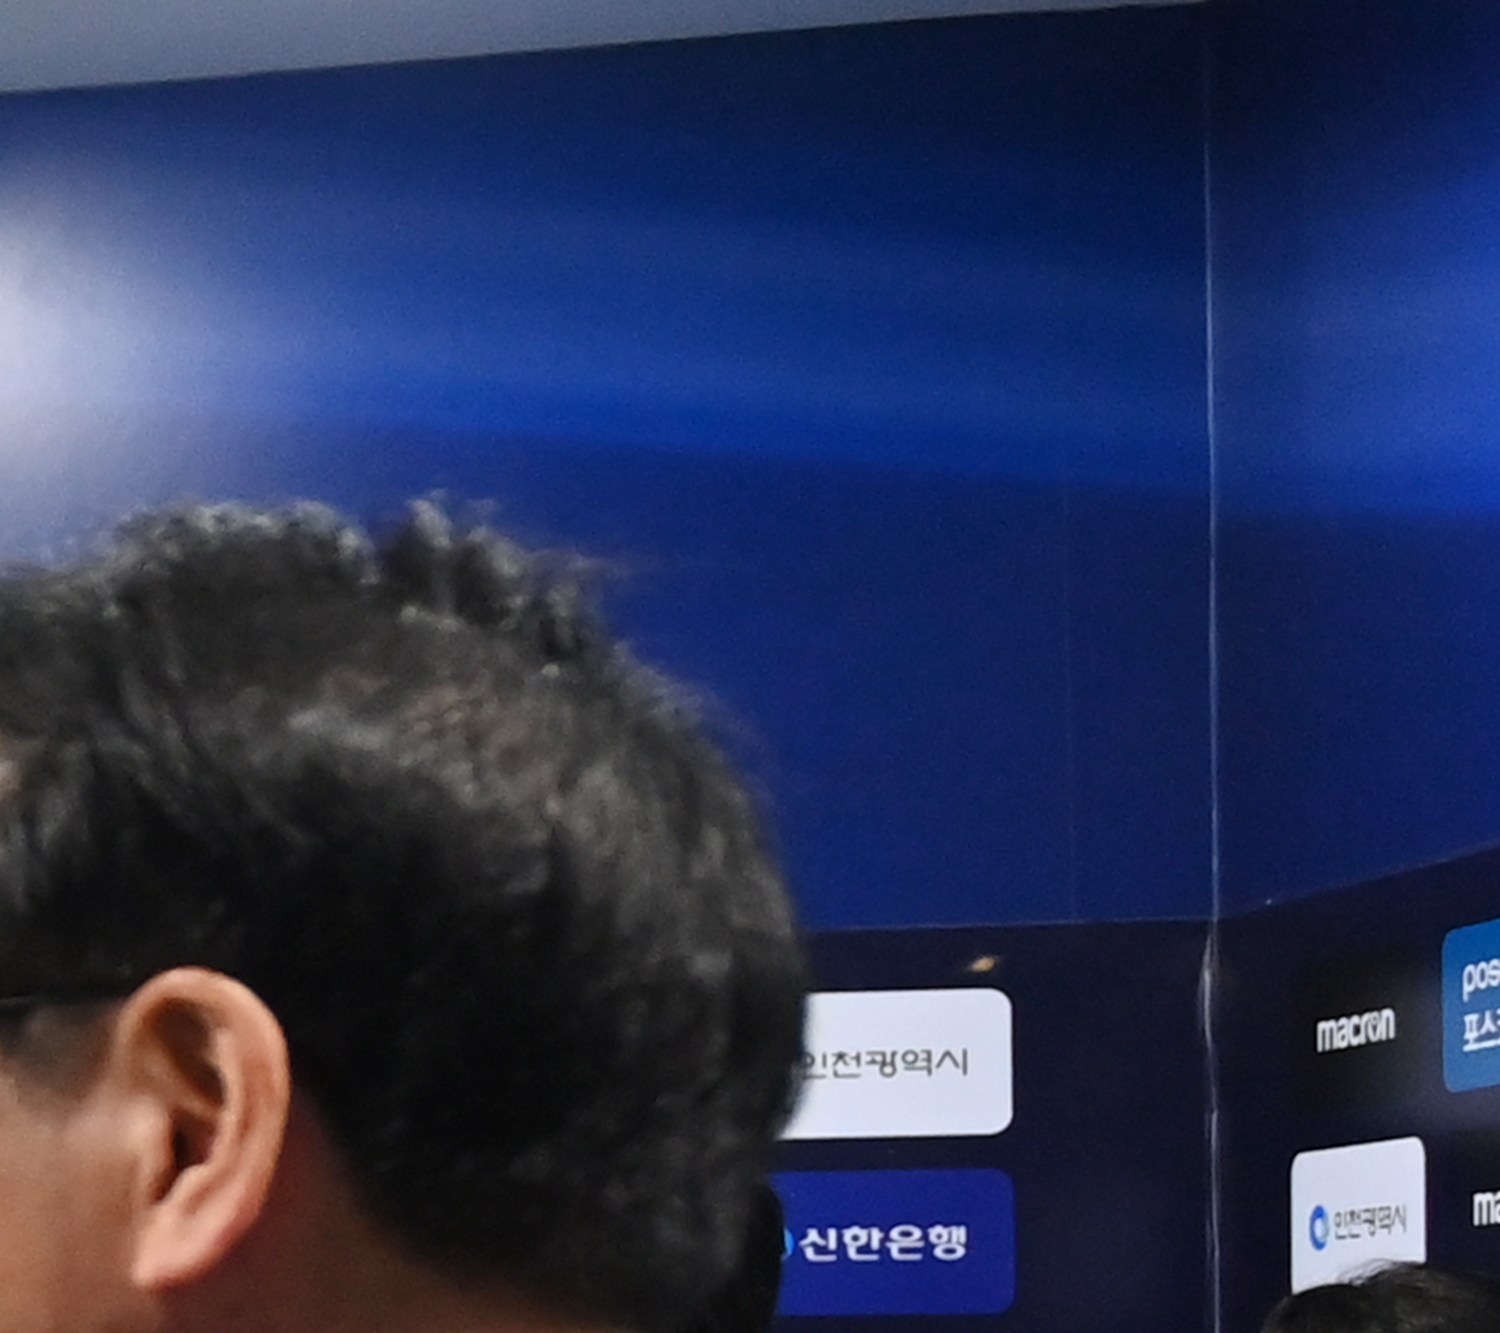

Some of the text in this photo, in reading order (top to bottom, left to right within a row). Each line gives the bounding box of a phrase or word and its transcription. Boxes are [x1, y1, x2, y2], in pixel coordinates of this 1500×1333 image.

[1462, 958, 1500, 1003] pos
[1316, 1008, 1396, 1053] macron
[799, 1224, 968, 1263] 신한은행
